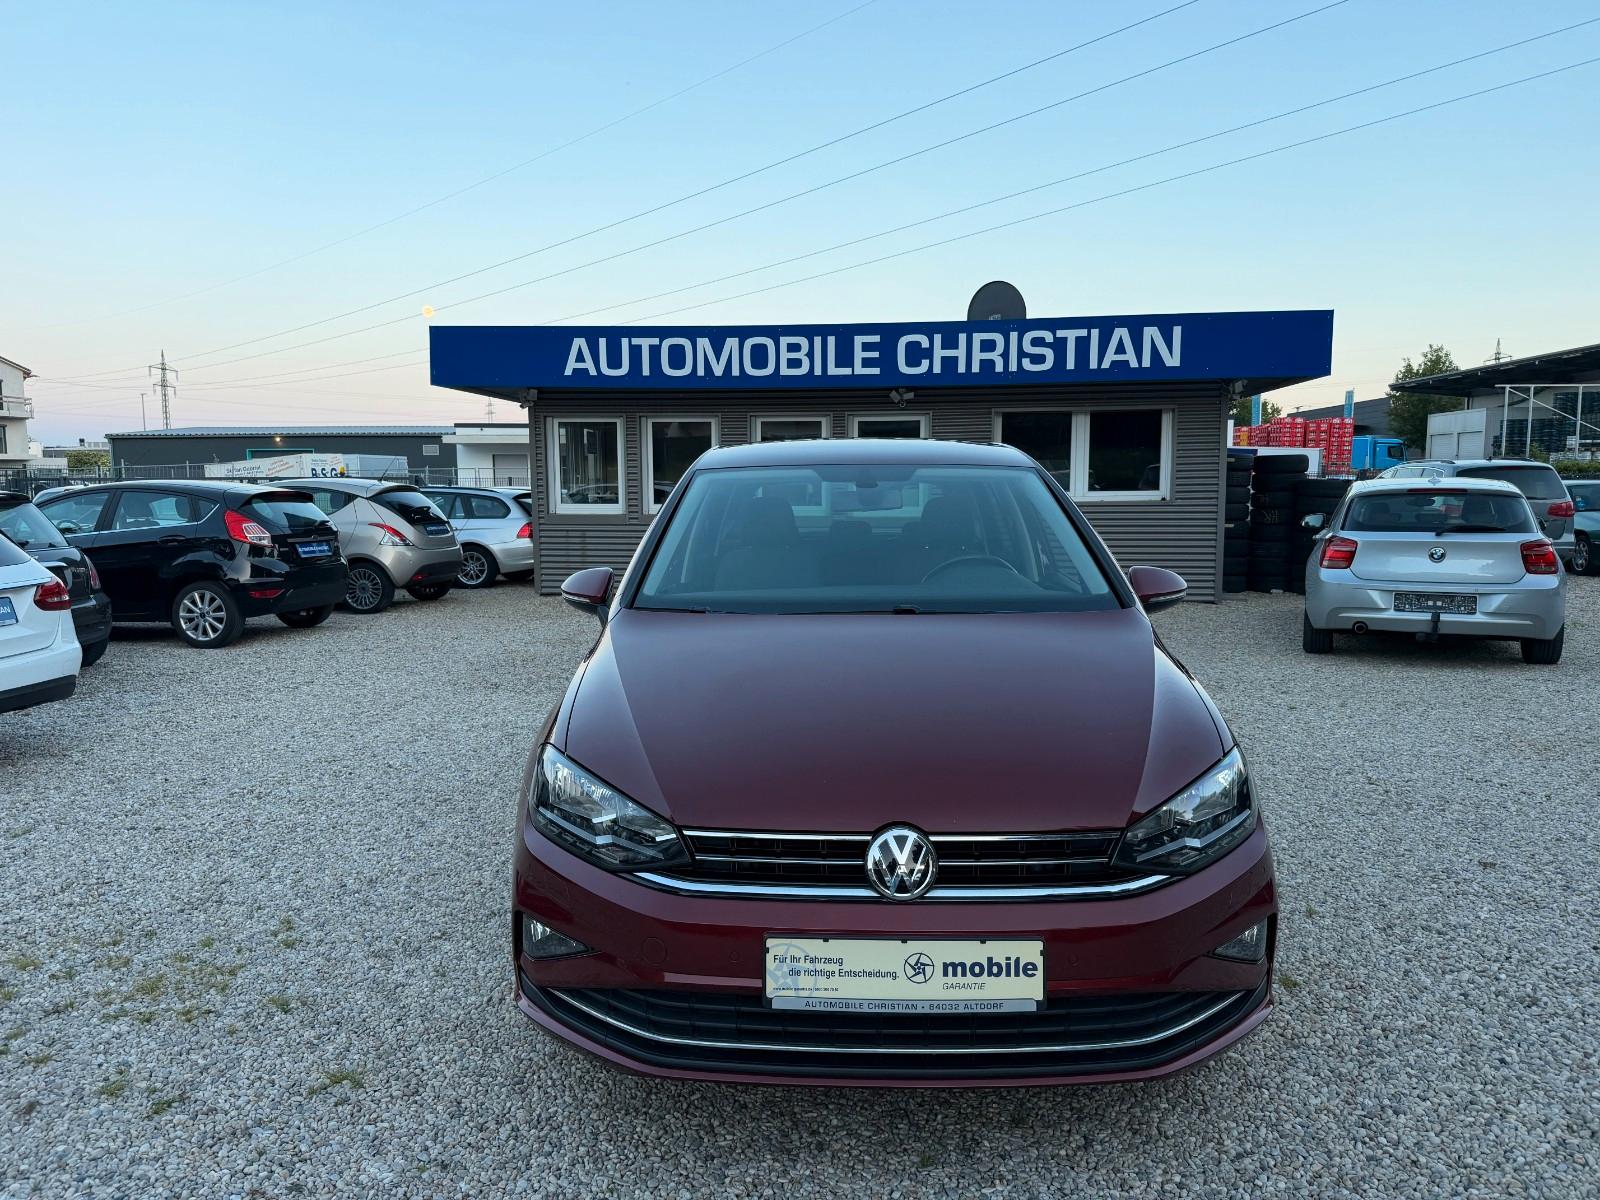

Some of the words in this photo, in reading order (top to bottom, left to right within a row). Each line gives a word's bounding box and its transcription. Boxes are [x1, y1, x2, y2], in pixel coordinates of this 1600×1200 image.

[564, 336, 881, 378] AUTOMOBILE
[897, 325, 1183, 376] CHRISTIAN
[773, 955, 788, 964] Für
[790, 955, 801, 964] Ihr
[804, 955, 844, 966] Fahrzeug
[942, 956, 1039, 978] mobile
[788, 967, 801, 977] die
[804, 967, 836, 979] richtige
[838, 968, 900, 981] Entscheidung.
[942, 982, 987, 991] GARANTIE
[804, 1000, 864, 1010] AUTOMOBILE
[867, 1002, 918, 1010] CHRISTIAN
[928, 1003, 960, 1011] 84032
[963, 1002, 1004, 1011] ALTDORF
